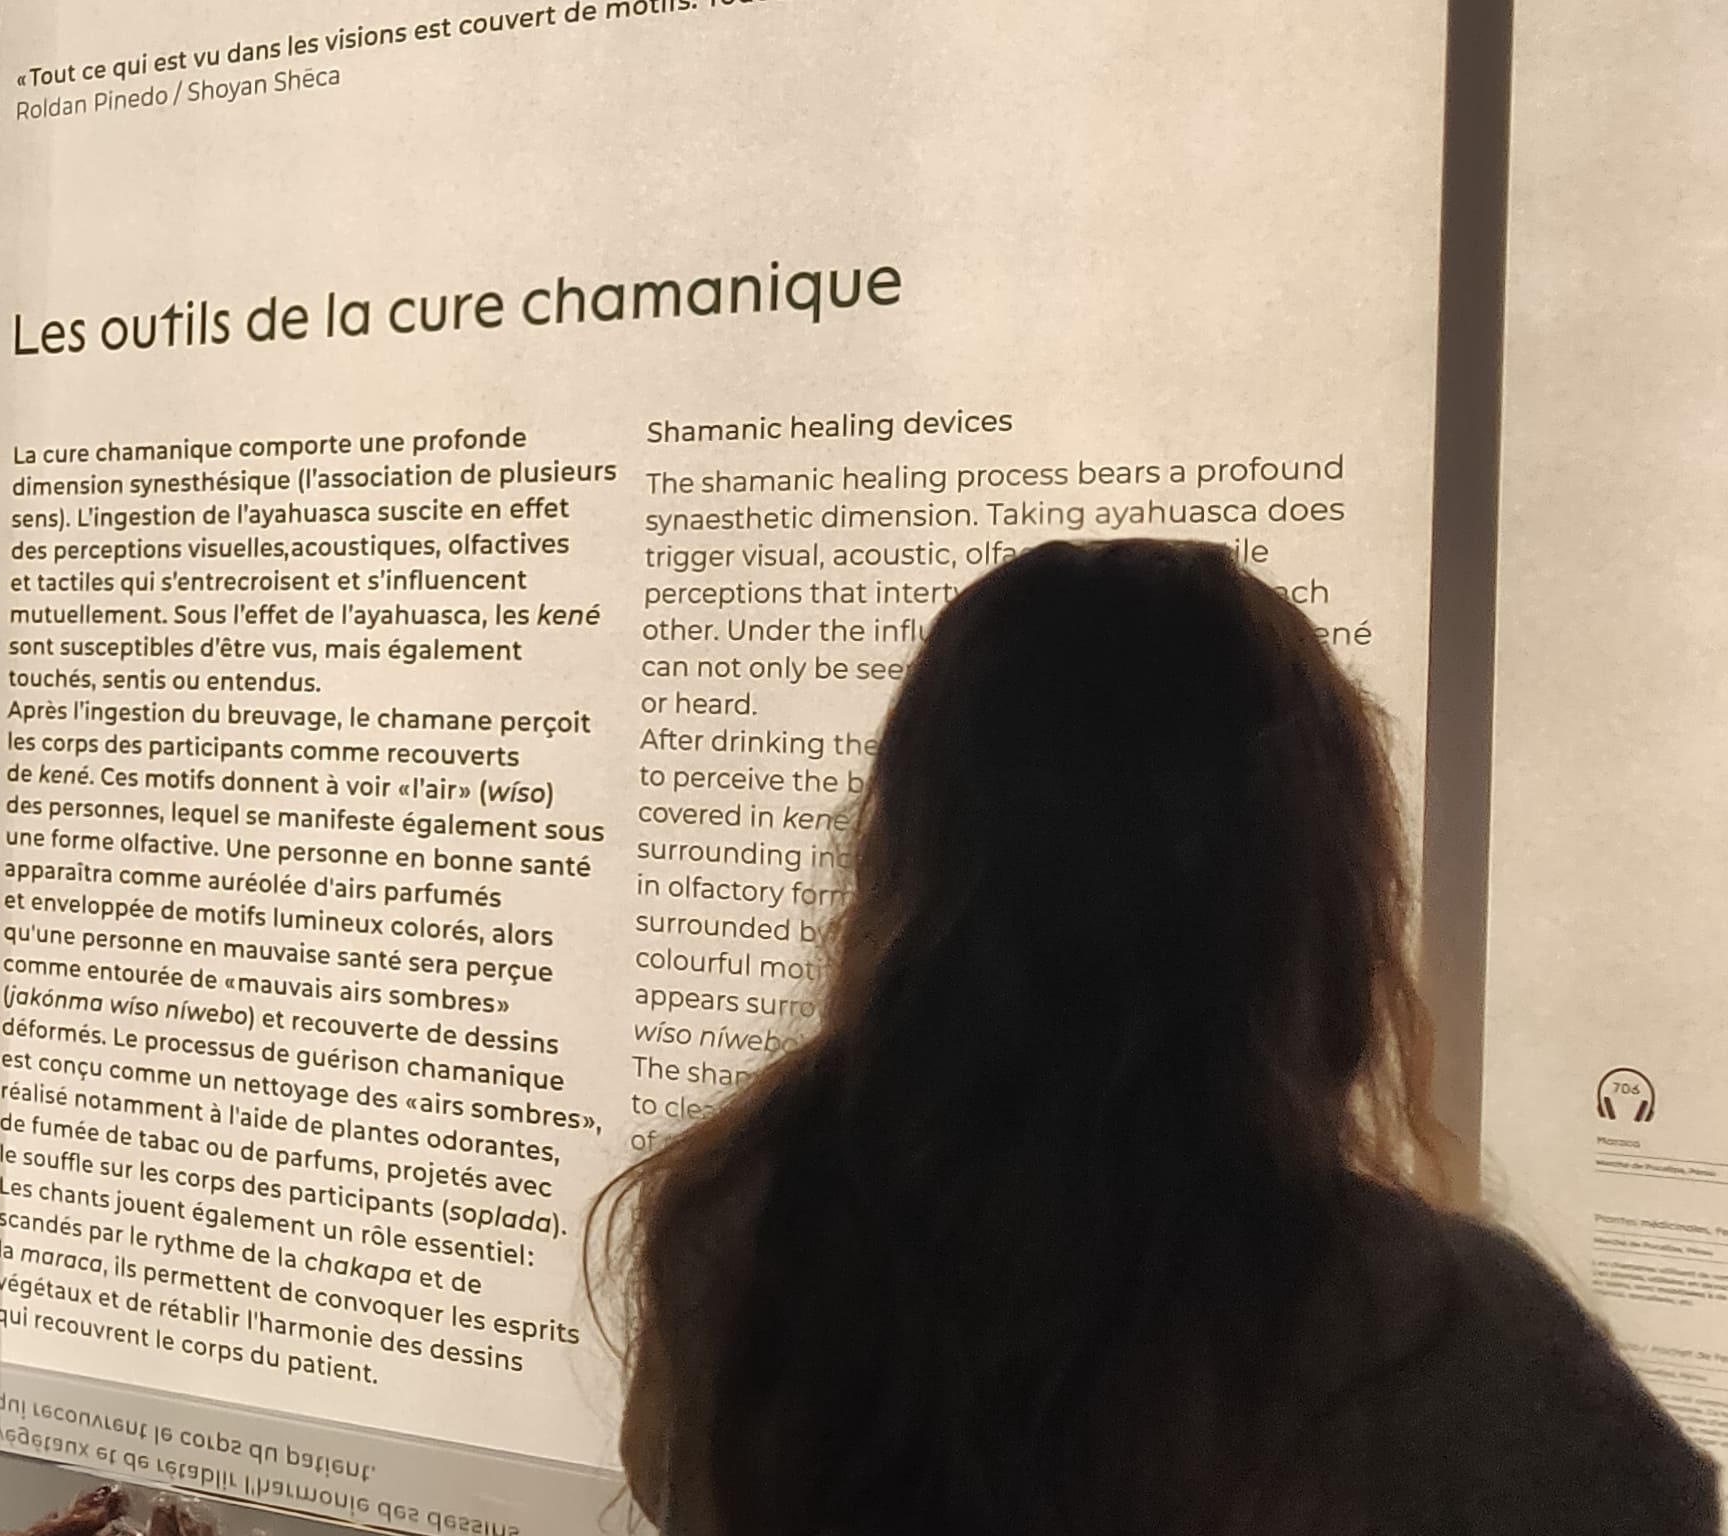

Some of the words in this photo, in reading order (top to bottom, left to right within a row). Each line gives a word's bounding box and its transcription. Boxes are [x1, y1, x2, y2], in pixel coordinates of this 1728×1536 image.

[82, 64, 107, 81] ce
[112, 52, 148, 82] qui
[153, 51, 187, 73] est
[193, 49, 220, 68] vu
[227, 41, 281, 64] dans
[288, 35, 319, 56] les
[324, 25, 407, 52] visions
[414, 18, 452, 41] est
[458, 5, 557, 36] couvert
[564, 0, 597, 24] de
[16, 96, 87, 121] Roldan
[94, 85, 168, 112] Pinedo
[172, 79, 183, 107] /
[187, 78, 267, 103] Shoyan
[14, 313, 86, 356] Les
[100, 299, 230, 351] outils
[246, 295, 309, 343] de
[326, 291, 371, 338] la
[388, 291, 504, 334] cure
[521, 260, 902, 326] chamanique
[13, 445, 37, 465] La
[43, 447, 90, 464] cure
[95, 437, 233, 464] chamanique
[238, 435, 352, 461] comporte
[359, 436, 405, 454] une
[412, 425, 527, 457] profonde
[646, 416, 782, 444] Shamanic
[790, 412, 894, 442] healing
[903, 408, 1013, 435] devices
[12, 473, 124, 497] dimension
[129, 469, 291, 499] synesthésique
[298, 463, 452, 495] (l'association
[460, 462, 492, 485] de
[499, 459, 617, 490] plusieurs
[645, 471, 695, 495] The
[701, 466, 835, 494] shamanic
[843, 464, 947, 494] healing
[957, 467, 1069, 494] process
[1078, 459, 1161, 485] bears
[1169, 464, 1186, 484] a
[1197, 453, 1344, 489] profound
[11, 507, 71, 533] sens).
[77, 504, 196, 532] L'ingestion
[202, 504, 231, 525] de
[237, 502, 370, 529] l'ayahuasca
[377, 497, 464, 522] suscite
[470, 503, 501, 520] en
[509, 496, 570, 519] effet
[645, 505, 814, 537] synaesthetic
[821, 502, 978, 529] dimension.
[985, 500, 1085, 530] Taking
[1095, 499, 1257, 529] ayahuasca
[1268, 495, 1345, 522] does
[11, 540, 48, 560] des
[54, 537, 182, 565] perceptions
[448, 531, 570, 556] olfactives
[644, 544, 736, 573] trigger
[741, 542, 825, 570] visual,
[833, 541, 957, 569] acoustic,
[644, 580, 802, 610] perceptions
[809, 580, 868, 604] that
[1314, 619, 1372, 646] ené
[8, 668, 97, 692] touchés,
[102, 668, 167, 690] sentis
[172, 674, 200, 691] ou
[206, 671, 321, 693] entendus.
[641, 660, 689, 678] can
[697, 657, 742, 679] not
[749, 655, 807, 685] only
[815, 655, 849, 680] be
[7, 700, 68, 724] Après
[73, 699, 185, 726] l'ingestion
[191, 702, 220, 724] du
[228, 703, 343, 732] breuvage,
[350, 706, 371, 728] le
[377, 707, 493, 731] chamane
[500, 709, 592, 739] perçoit
[641, 696, 668, 714] or
[675, 691, 758, 716] heard.
[639, 727, 705, 752] After
[711, 728, 824, 760] drinking
[833, 732, 879, 756] the
[639, 766, 666, 787] to
[673, 766, 785, 793] perceive
[791, 768, 838, 793] the
[638, 803, 741, 827] covered
[751, 803, 774, 829] in
[4, 861, 113, 884] apparaîtra
[119, 869, 202, 889] comme
[208, 871, 307, 896] auréolée
[313, 876, 377, 900] d'airs
[383, 882, 502, 908] parfumés
[3, 958, 81, 978] comme
[87, 964, 184, 987] entourée
[189, 967, 218, 990] de
[224, 976, 333, 1000] «mauvais
[339, 980, 382, 1004] airs
[388, 987, 510, 1014] sombres»
[635, 987, 739, 1013] appears
[110, 995, 159, 1018] wíso
[262, 1010, 285, 1030] et
[292, 1015, 419, 1042] recouverte
[426, 1022, 457, 1046] de
[464, 1025, 559, 1055] dessins
[0, 1143, 17, 1164] le
[23, 1151, 94, 1174] souffle
[99, 1161, 134, 1179] sur
[139, 1160, 169, 1184] les
[175, 1170, 235, 1196] corps
[241, 1174, 282, 1199] des
[289, 1184, 434, 1218] participants
[442, 1198, 567, 1240] (soplada).
[34, 1314, 149, 1348] recouvrent
[156, 1328, 175, 1351] le
[181, 1338, 244, 1364] corps
[250, 1344, 280, 1368] du
[287, 1354, 378, 1385] patient.
